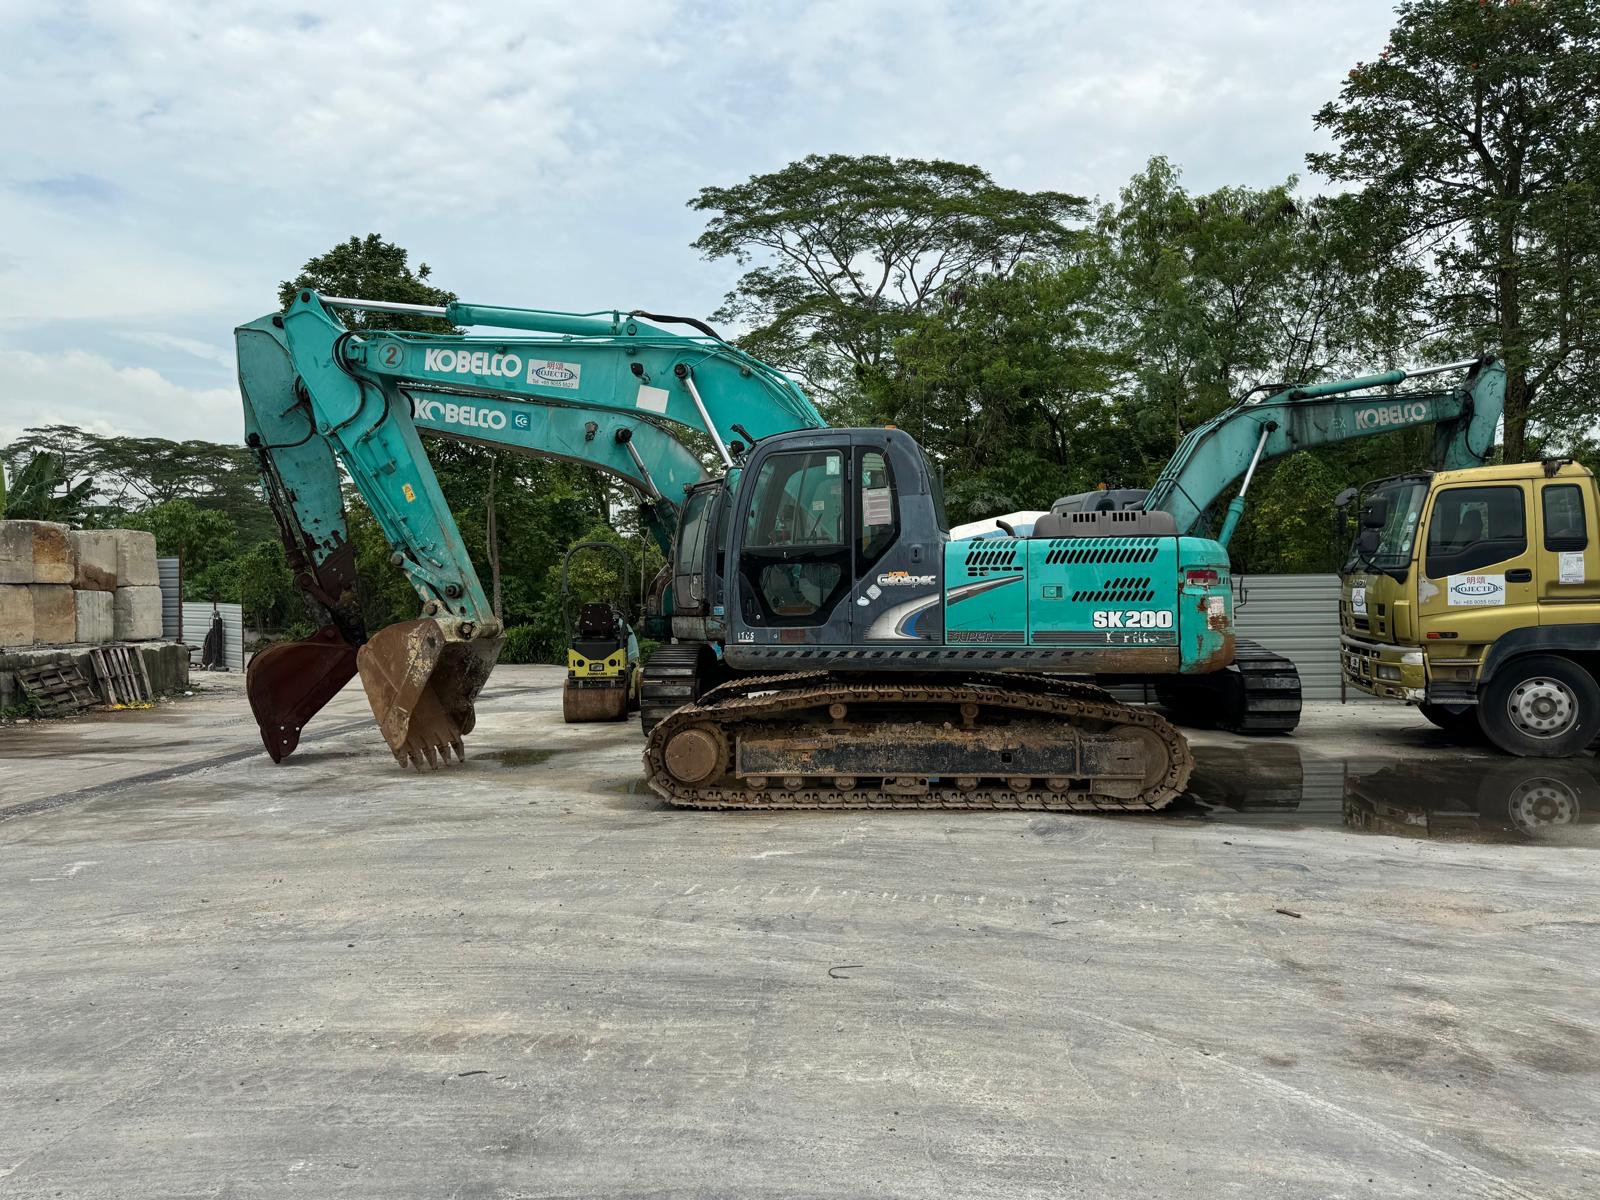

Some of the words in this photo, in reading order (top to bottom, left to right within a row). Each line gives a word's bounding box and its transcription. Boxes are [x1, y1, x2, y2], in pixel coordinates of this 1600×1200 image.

[386, 347, 397, 364] 2
[424, 348, 522, 377] KOBELCO
[413, 398, 506, 430] KOBELCO
[1355, 402, 1426, 430] KOBELCO
[1093, 610, 1173, 628] SK200
